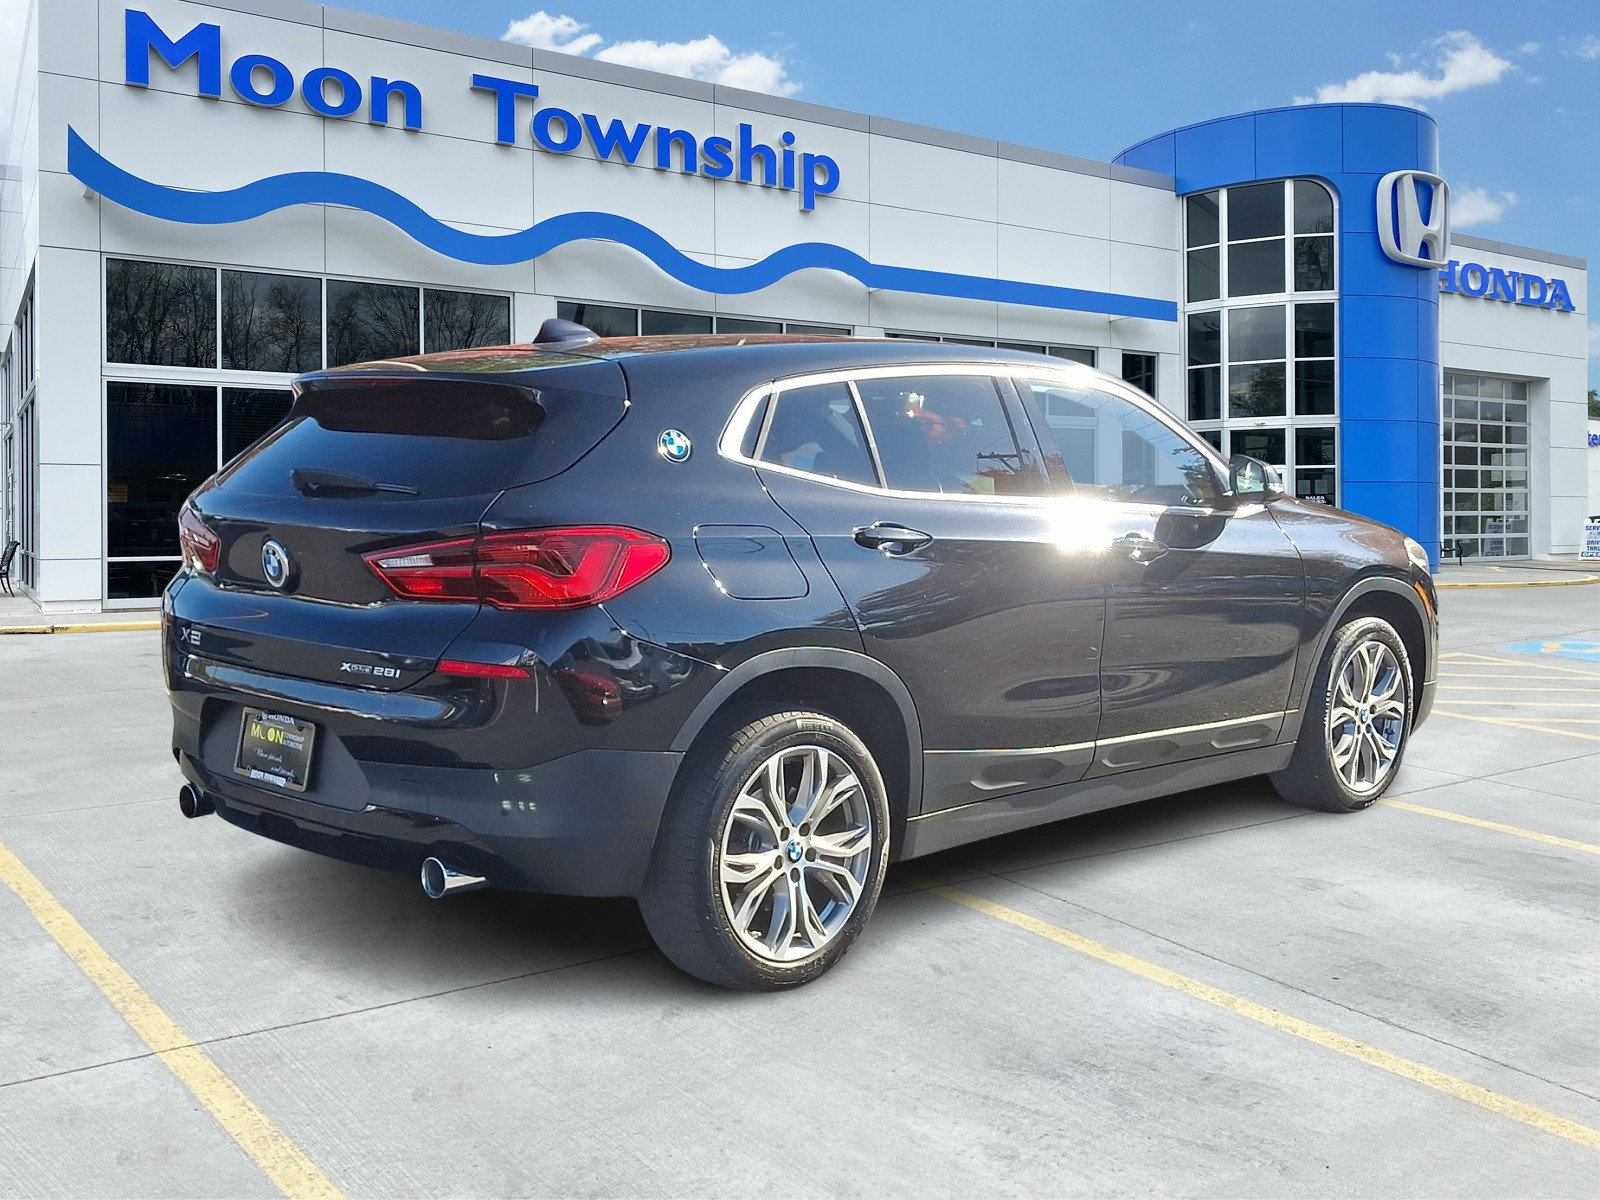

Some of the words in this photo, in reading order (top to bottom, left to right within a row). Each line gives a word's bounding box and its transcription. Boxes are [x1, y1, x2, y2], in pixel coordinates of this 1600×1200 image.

[125, 9, 422, 130] Moon
[470, 73, 840, 211] Township
[1438, 259, 1576, 312] HONDA
[181, 627, 201, 645] X2
